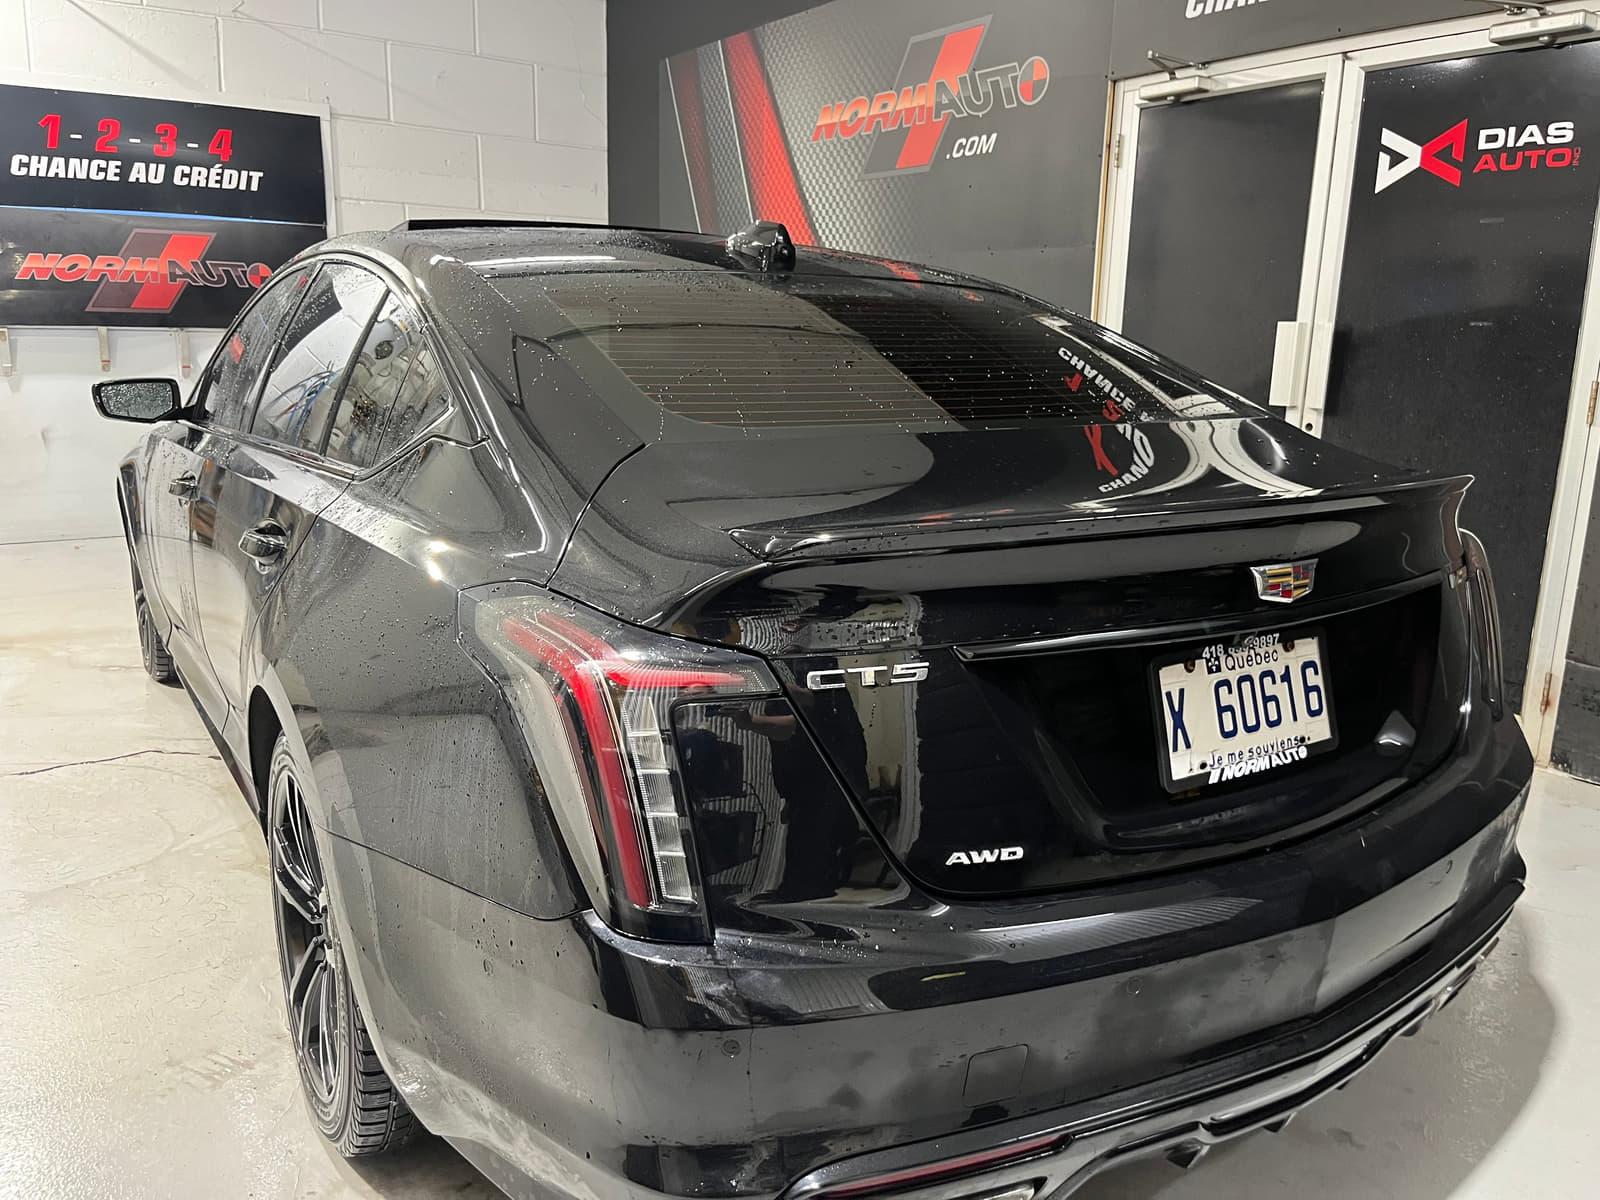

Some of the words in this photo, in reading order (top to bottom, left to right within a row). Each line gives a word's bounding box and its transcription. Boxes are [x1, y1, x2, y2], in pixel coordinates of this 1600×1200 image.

[946, 133, 998, 160] .COM
[1477, 121, 1575, 151] DIAS
[10, 154, 122, 182] CHANCE
[128, 160, 166, 185] AU
[173, 163, 264, 192] CRÉDIT
[1473, 147, 1573, 174] AUTO
[1202, 643, 1225, 659] 418
[806, 661, 930, 690] CT5
[1165, 687, 1192, 753] X
[1213, 659, 1324, 739] 60616
[1209, 751, 1223, 768] Je
[1227, 749, 1244, 763] me
[945, 846, 1024, 866] AWD
